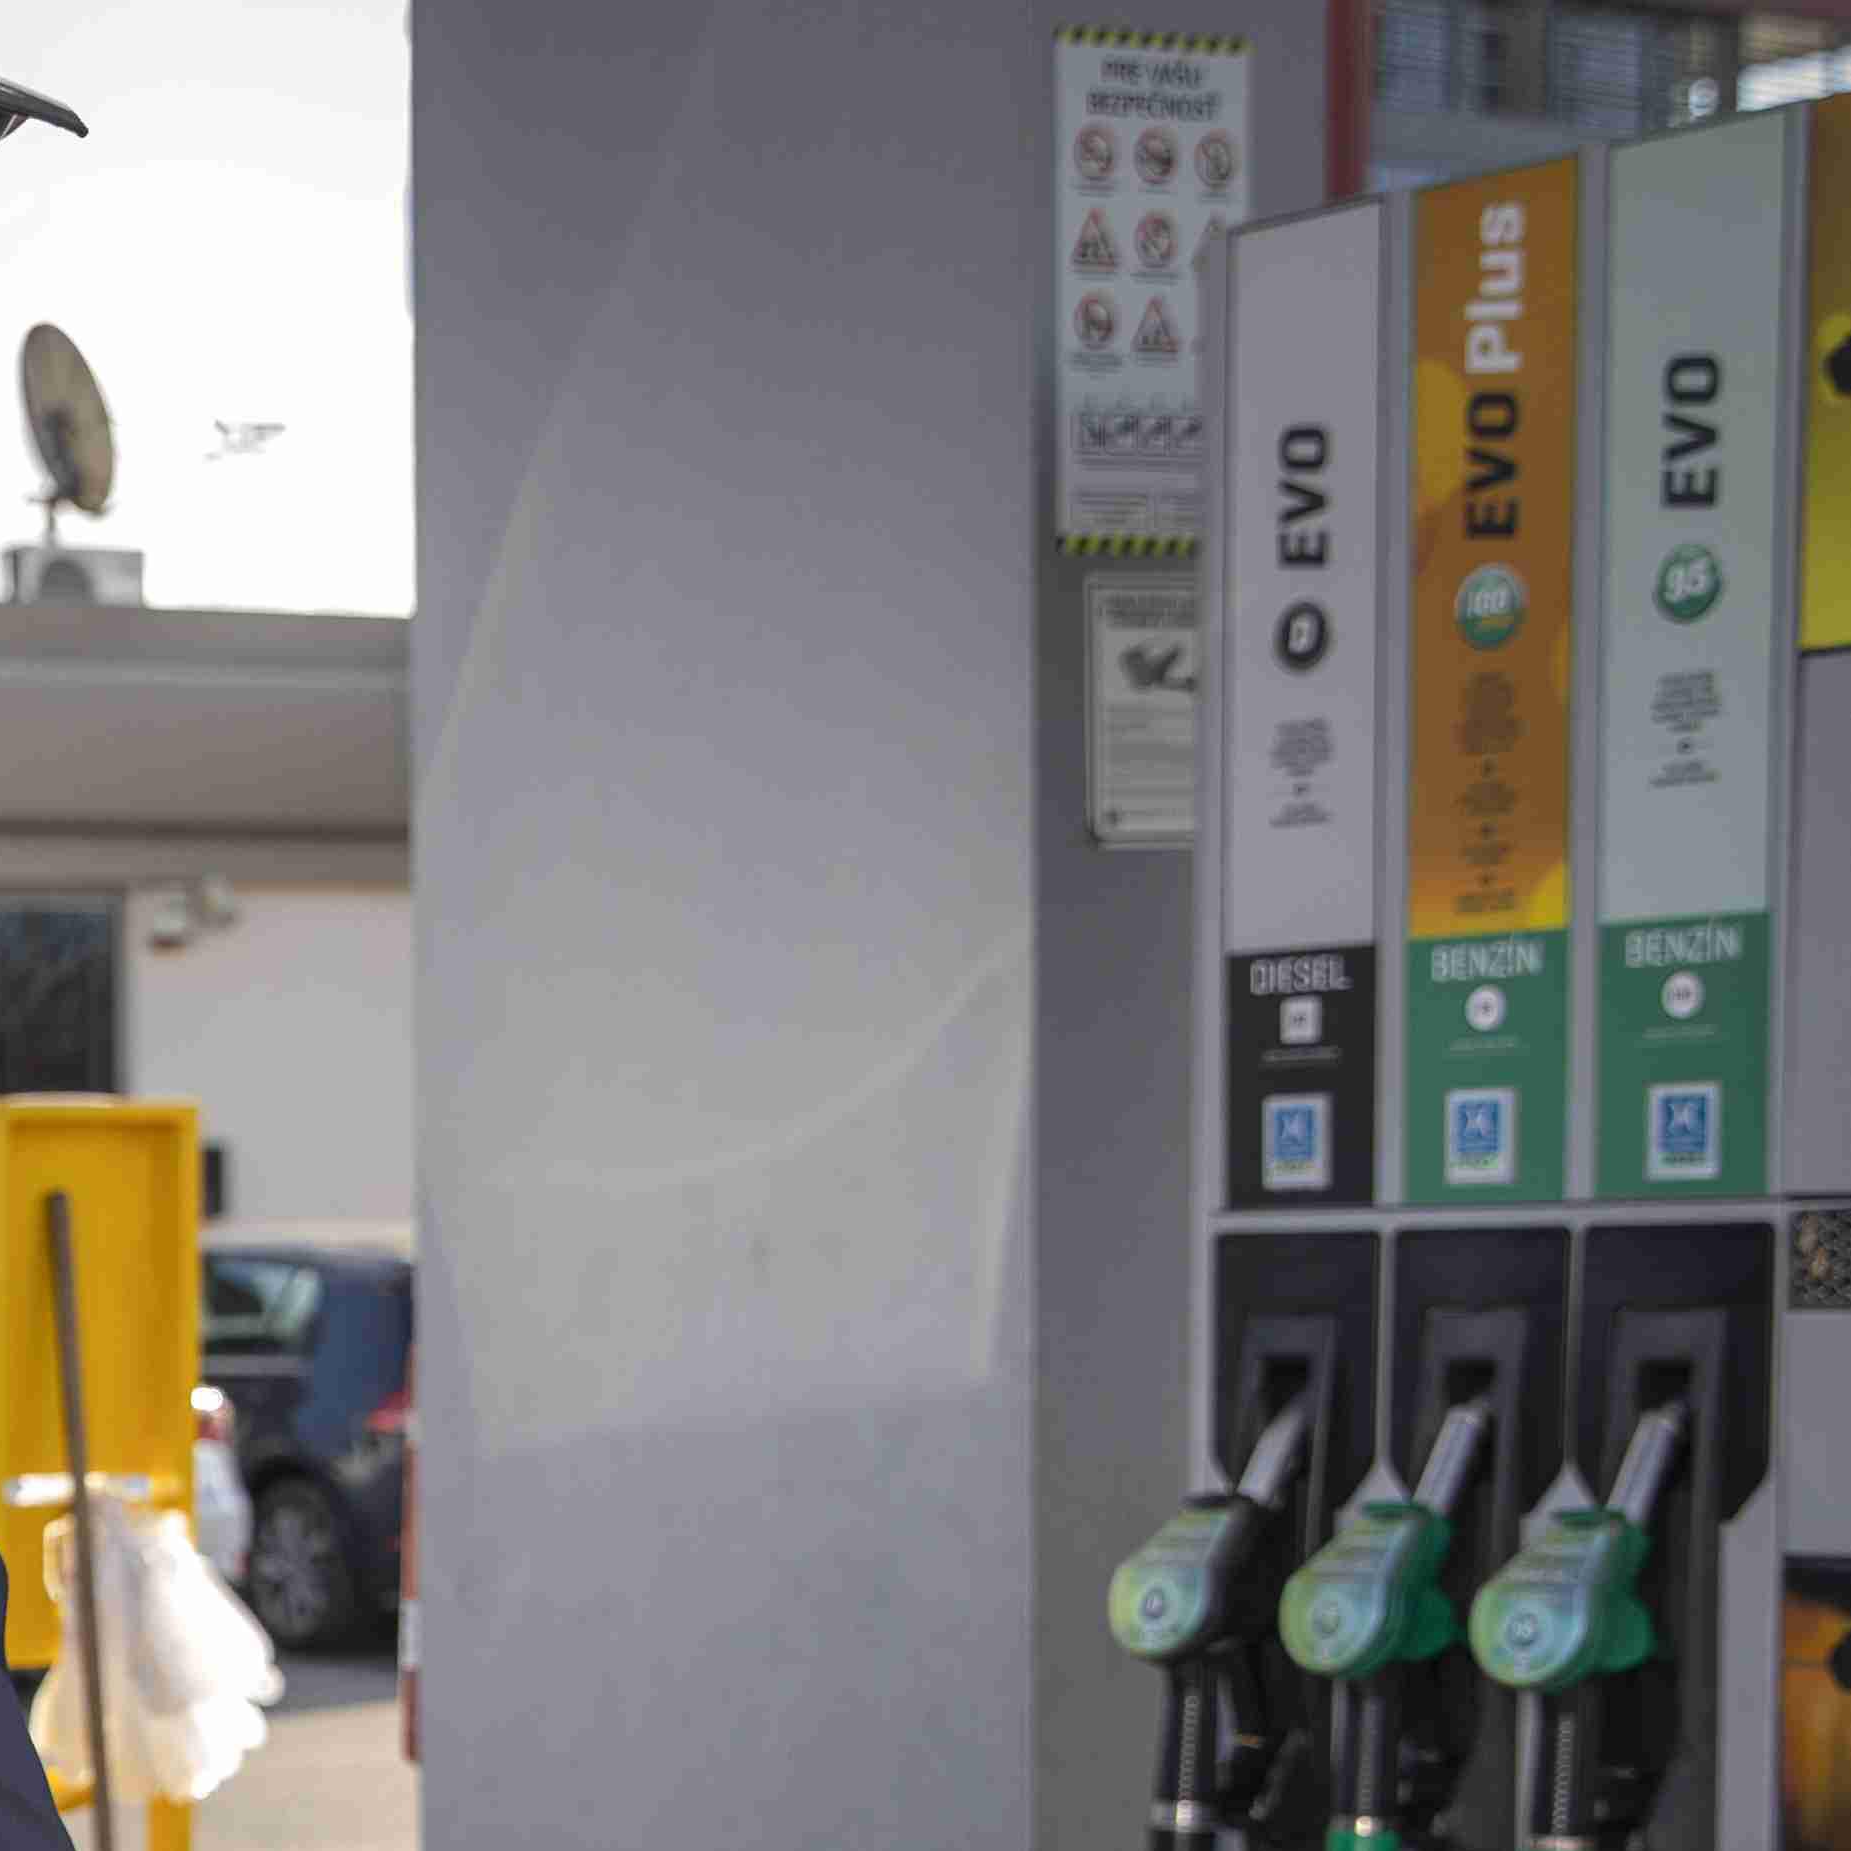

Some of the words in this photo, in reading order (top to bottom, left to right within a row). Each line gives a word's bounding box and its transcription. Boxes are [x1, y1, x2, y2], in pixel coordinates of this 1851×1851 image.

[1467, 203, 1526, 374] Plus
[1280, 425, 1329, 567] EVO
[1467, 392, 1519, 540] EVO
[1663, 353, 1722, 508] EVO
[1250, 954, 1352, 995] DIESEL
